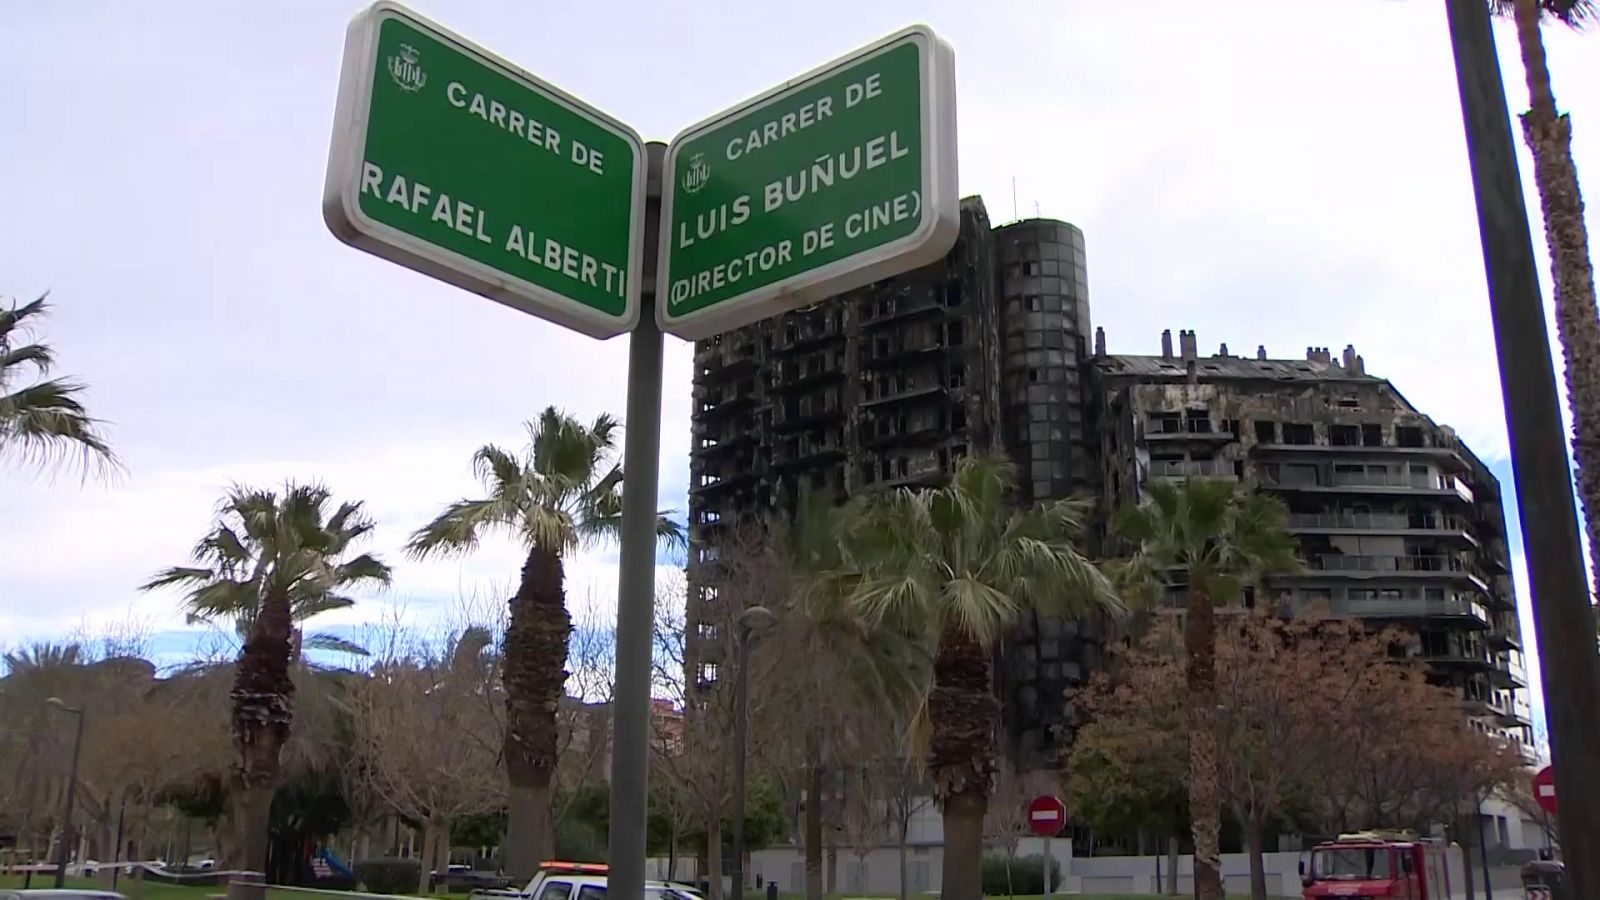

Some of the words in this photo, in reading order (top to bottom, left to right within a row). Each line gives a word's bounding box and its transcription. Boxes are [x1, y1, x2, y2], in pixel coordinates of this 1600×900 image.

[446, 81, 562, 154] CARRER
[571, 140, 604, 175] DE
[726, 96, 833, 161] CARRER
[845, 73, 882, 109] DE
[361, 160, 492, 243] RAFAEL
[505, 225, 625, 298] ALBERTI
[670, 240, 792, 306] (DIRECTOR
[803, 222, 834, 256] DE
[845, 190, 921, 238] CINE)
[679, 195, 750, 249] LUIS
[764, 131, 909, 212] BUÑUEL
